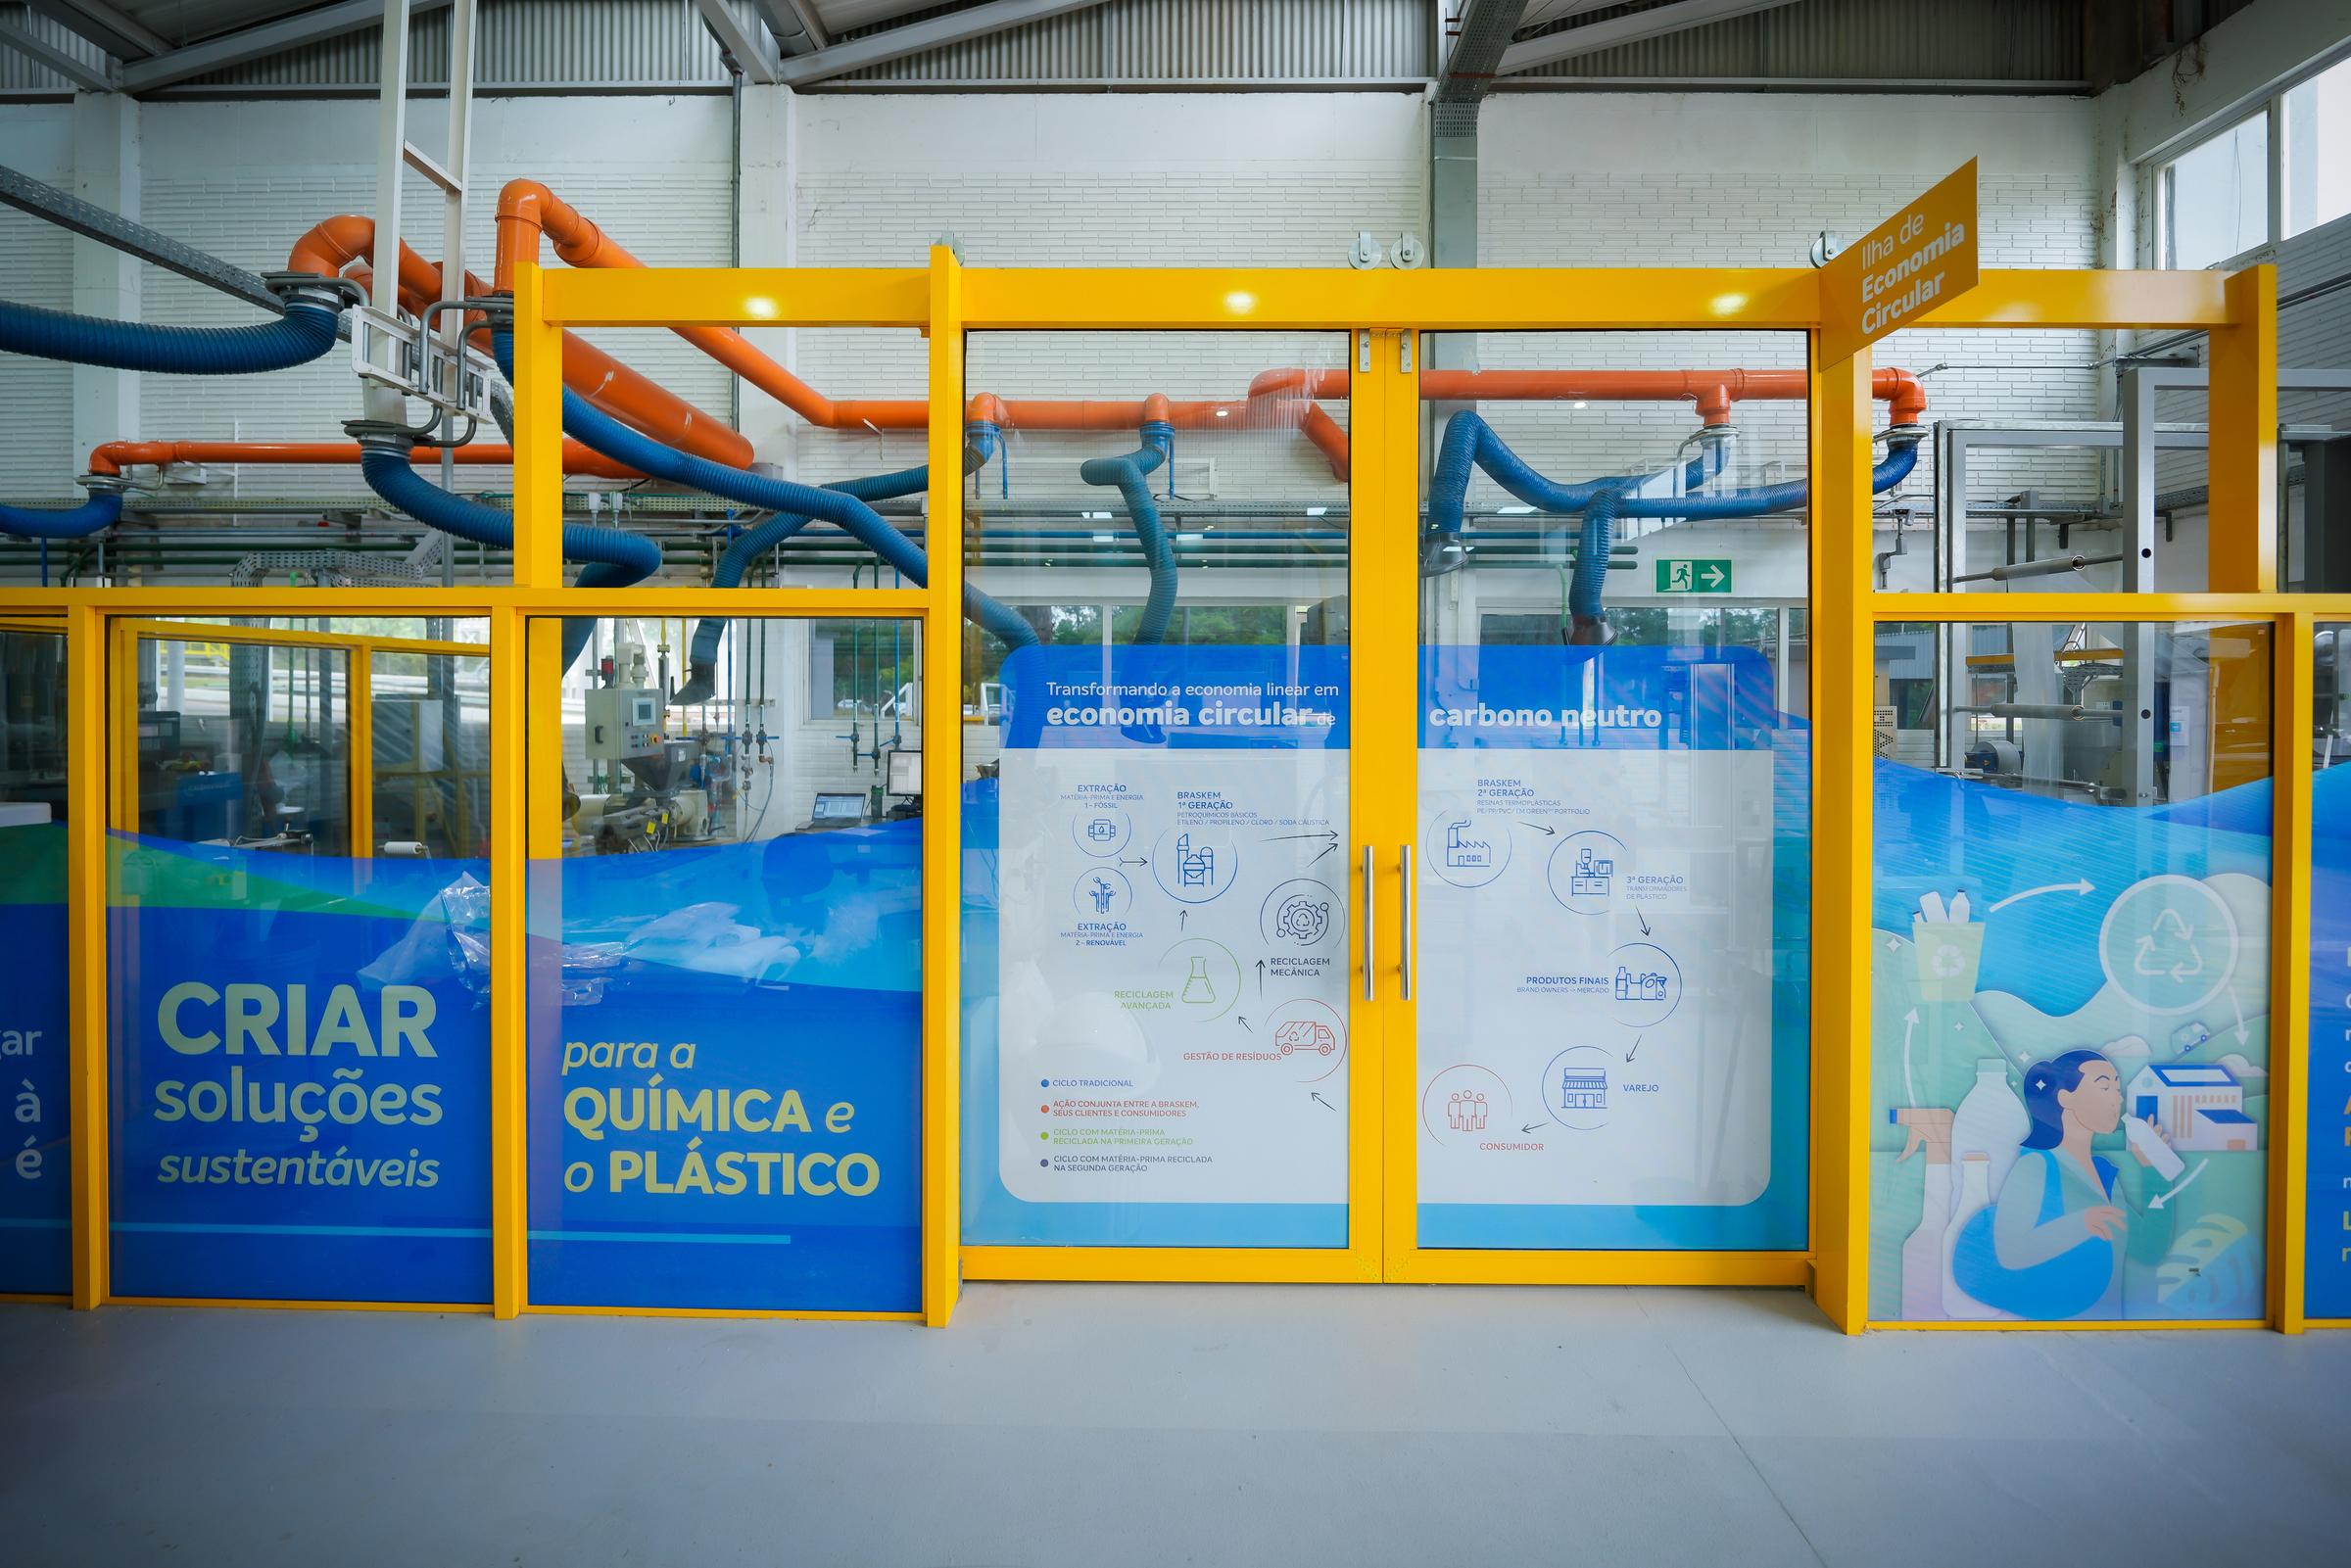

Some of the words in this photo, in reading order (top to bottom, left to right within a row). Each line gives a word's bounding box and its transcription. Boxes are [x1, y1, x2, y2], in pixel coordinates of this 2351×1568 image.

[1863, 234, 1894, 270] Ilha
[1899, 214, 1925, 244] de
[1863, 221, 1964, 304] Economia
[1861, 271, 1944, 335] Circular
[1046, 682, 1168, 696] Transformando
[1172, 686, 1180, 696] a
[1185, 683, 1262, 696] economia
[1267, 682, 1311, 696] linear
[1314, 687, 1339, 696] em
[1046, 702, 1190, 727] economia
[1198, 701, 1314, 727] circular
[1317, 712, 1336, 726] de
[1429, 702, 1553, 727] carbono
[1560, 704, 1662, 728] neutro
[1078, 783, 1127, 794] EXTRAÇÃO
[1477, 779, 1521, 787] BRASKEM
[1489, 787, 1535, 798] GERAÇÃO
[1188, 799, 1233, 811] GERAÇÃO
[1638, 875, 1684, 885] GERAÇÃO
[1078, 922, 1127, 932] EXTRAÇÃO
[1271, 967, 1319, 976] MECÂNICA
[1579, 976, 1609, 985] FINAIS
[1114, 990, 1174, 999] RECICLAGEM
[1121, 1002, 1171, 1012] AVANÇADA
[158, 981, 439, 1058] CRIAR
[0, 1029, 43, 1060] ar
[561, 1041, 659, 1075] para
[669, 1043, 696, 1069] a
[1183, 1051, 1220, 1061] GESTÃO
[1235, 1051, 1281, 1061] RESÍDUOS
[1623, 1083, 1659, 1092] VAREJO
[15, 1077, 41, 1123] à
[153, 1066, 444, 1143] soluções
[1053, 1099, 1077, 1109] AÇÃO
[563, 1072, 812, 1141] QUÍMICA
[825, 1102, 855, 1133] e
[1100, 1127, 1165, 1136] MATÉRIA-PRIMA
[1154, 1136, 1193, 1147] GERAÇÃO
[1479, 1142, 1545, 1151] CONSUMIDOR
[15, 1135, 43, 1180] é
[1101, 1154, 1166, 1164] MATÉRIA-PRIMA
[158, 1146, 441, 1188] sustentáveis
[563, 1162, 595, 1193] o
[609, 1136, 881, 1197] PLÁSTICO
[1108, 1164, 1148, 1173] GERAÇÃO
